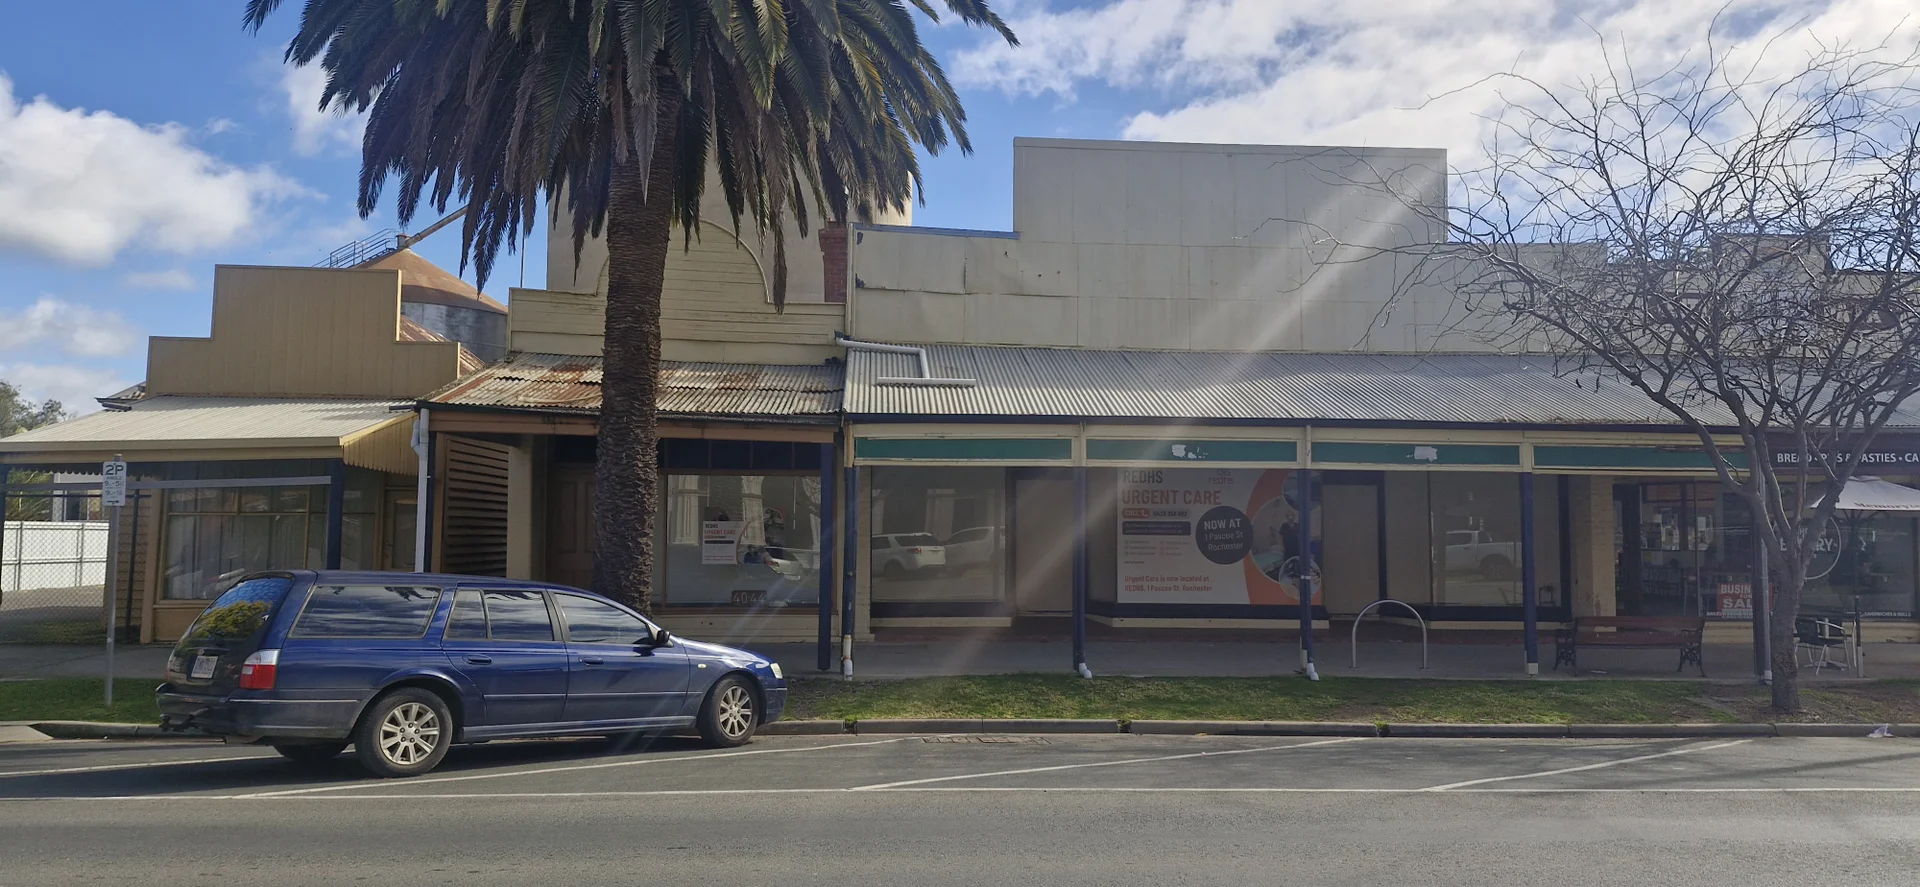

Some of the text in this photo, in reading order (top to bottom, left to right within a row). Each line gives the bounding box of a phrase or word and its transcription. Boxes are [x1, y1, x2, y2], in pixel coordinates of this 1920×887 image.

[105, 464, 124, 475] 2P
[1123, 470, 1163, 484] REDHS
[1208, 476, 1234, 485] redhs
[1122, 489, 1222, 505] URGENT CARE
[1203, 518, 1241, 530] NOW AT
[1209, 532, 1235, 541] Pascoe
[1235, 530, 1244, 539] St
[1208, 542, 1244, 551] Rochester
[1124, 575, 1145, 584] Urgent
[733, 591, 766, 604] 40-44
